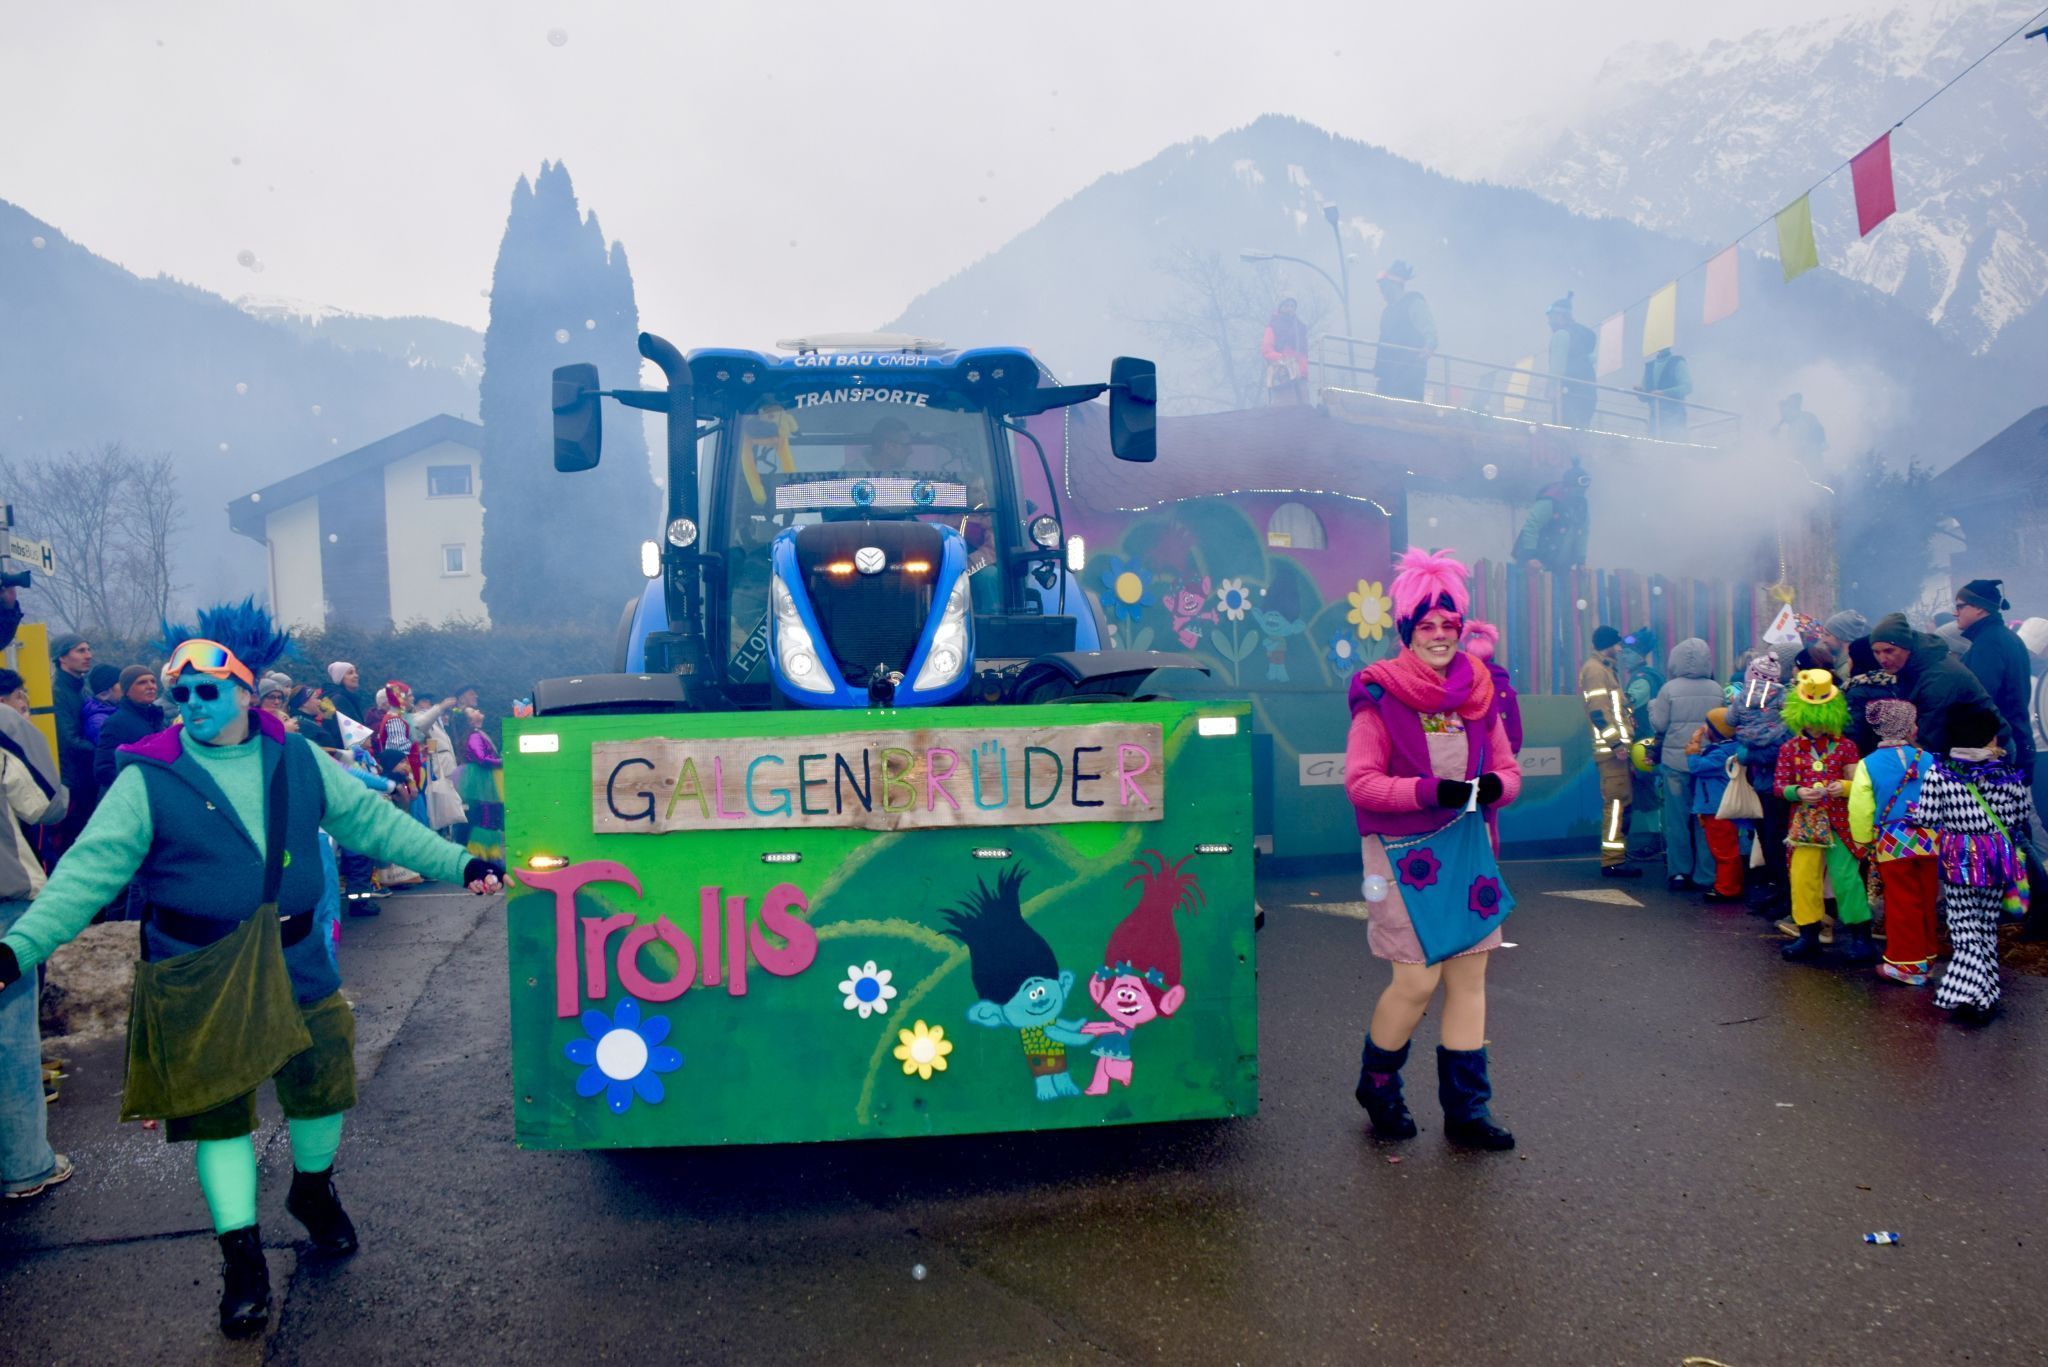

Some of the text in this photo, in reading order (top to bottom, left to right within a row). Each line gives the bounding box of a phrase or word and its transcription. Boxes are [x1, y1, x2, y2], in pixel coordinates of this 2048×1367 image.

[794, 355, 929, 367] CAN BAU GMBH
[794, 387, 930, 409] TRANSPORTE
[41, 545, 53, 571] H
[606, 739, 1151, 825] GALGENBRÜDER
[512, 859, 819, 1019] Trolls
